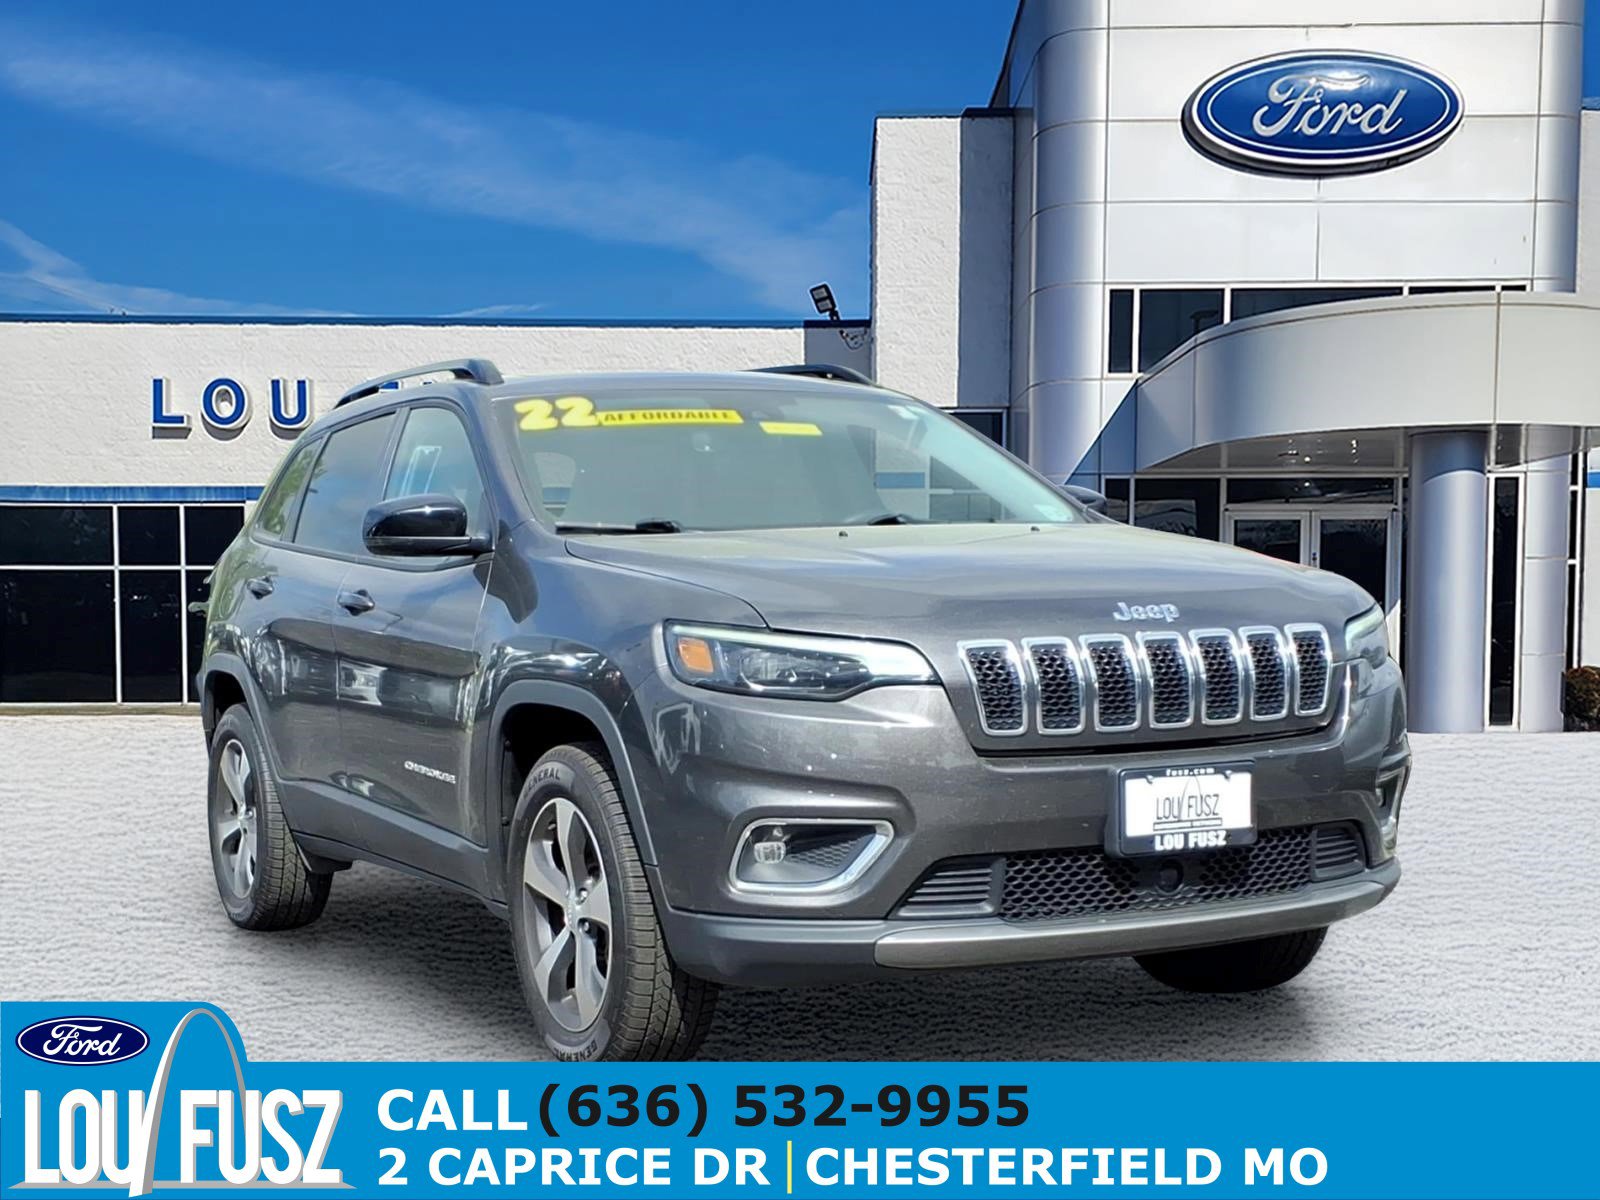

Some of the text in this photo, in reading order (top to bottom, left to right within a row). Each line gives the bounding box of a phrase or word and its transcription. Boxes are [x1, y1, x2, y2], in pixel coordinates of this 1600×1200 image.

[1252, 74, 1407, 137] Ford
[152, 377, 311, 429] LOU
[514, 396, 598, 431] 22
[1112, 601, 1180, 623] Jeep
[1156, 794, 1220, 820] LOU FUSZ
[1155, 830, 1227, 851] LOU FUSZ
